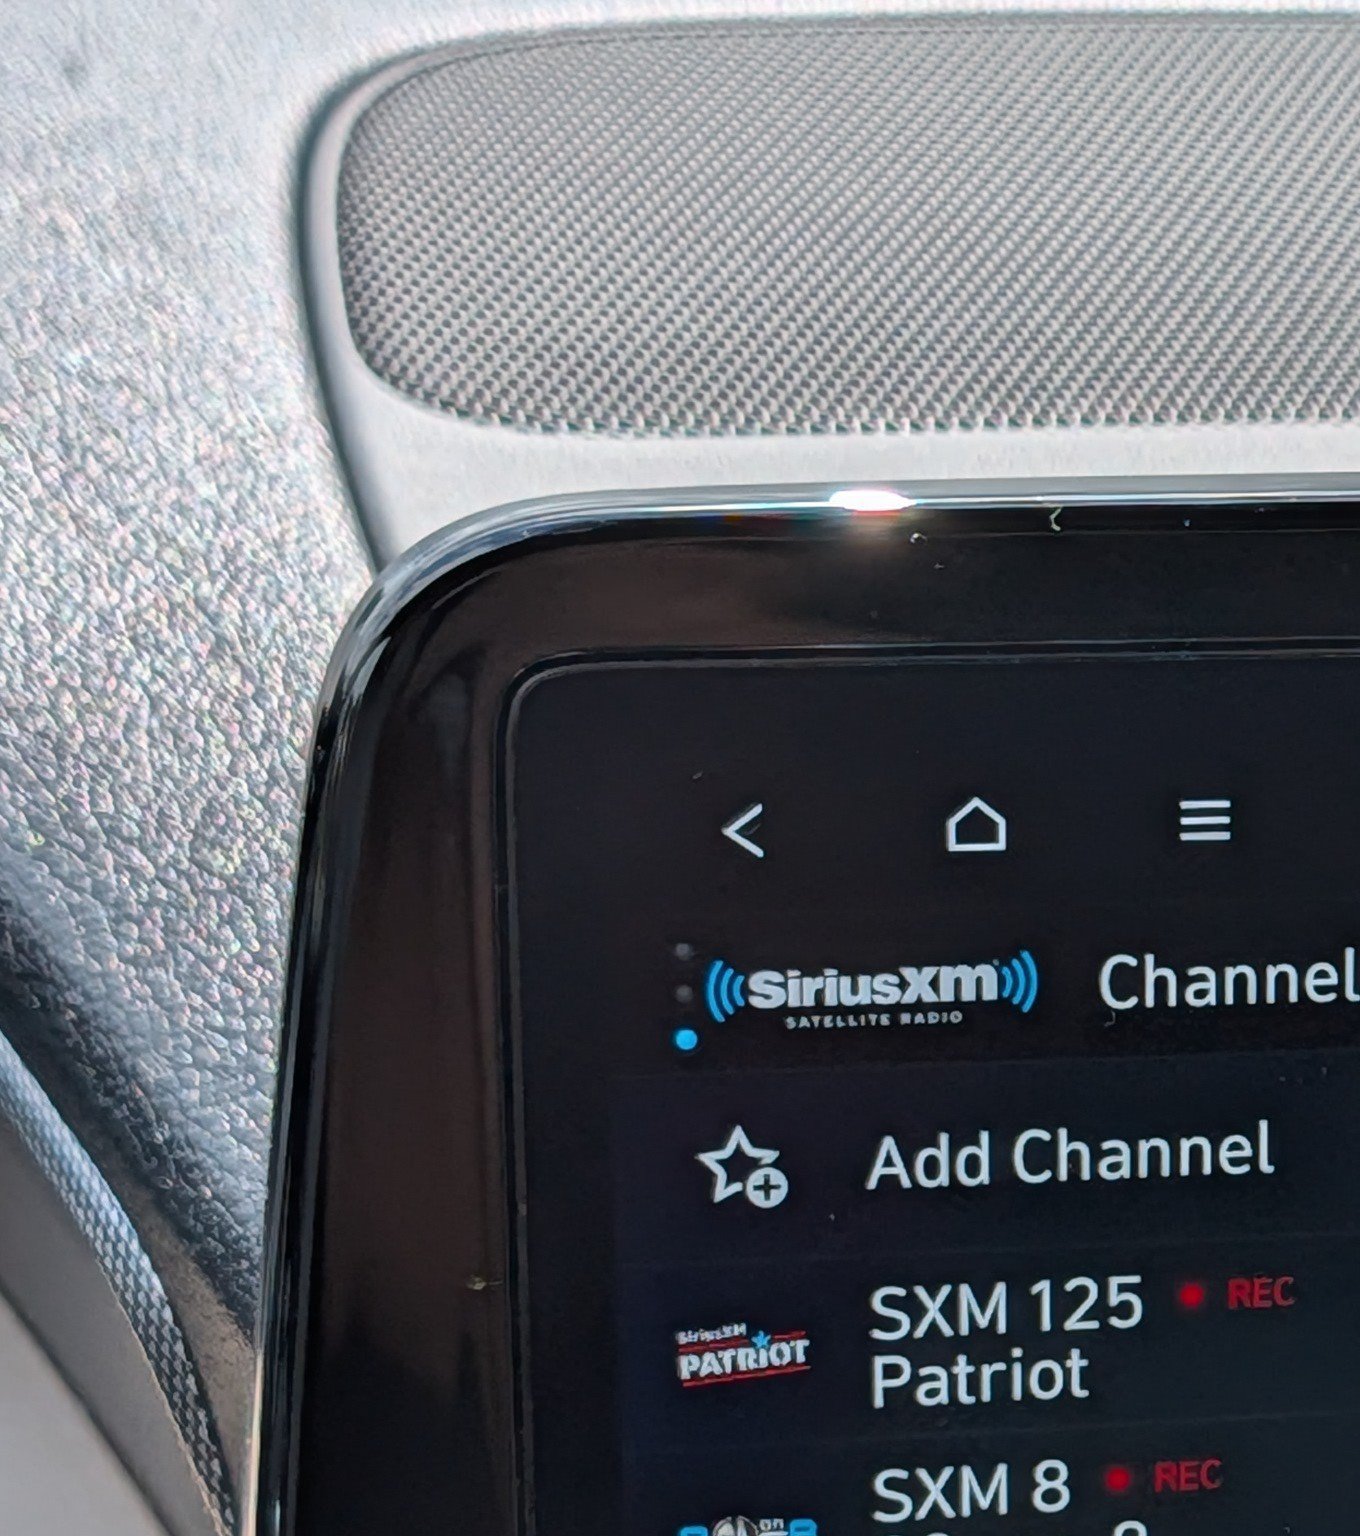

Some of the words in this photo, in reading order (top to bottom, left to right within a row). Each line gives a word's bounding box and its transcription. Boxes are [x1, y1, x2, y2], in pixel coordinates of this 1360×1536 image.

[785, 1013, 891, 1030] SATELLITE
[899, 1010, 963, 1026] RADIO
[866, 1130, 990, 1190] Add
[1013, 1119, 1275, 1184] Channel
[869, 1281, 1007, 1341] SXM
[1030, 1274, 1143, 1332] 125
[1227, 1276, 1294, 1309] REC
[678, 1339, 810, 1380] PATRIOT
[873, 1347, 1090, 1409] Patriot
[873, 1462, 1008, 1523] SXM
[1032, 1459, 1071, 1513] 8
[1154, 1458, 1221, 1492] REC
